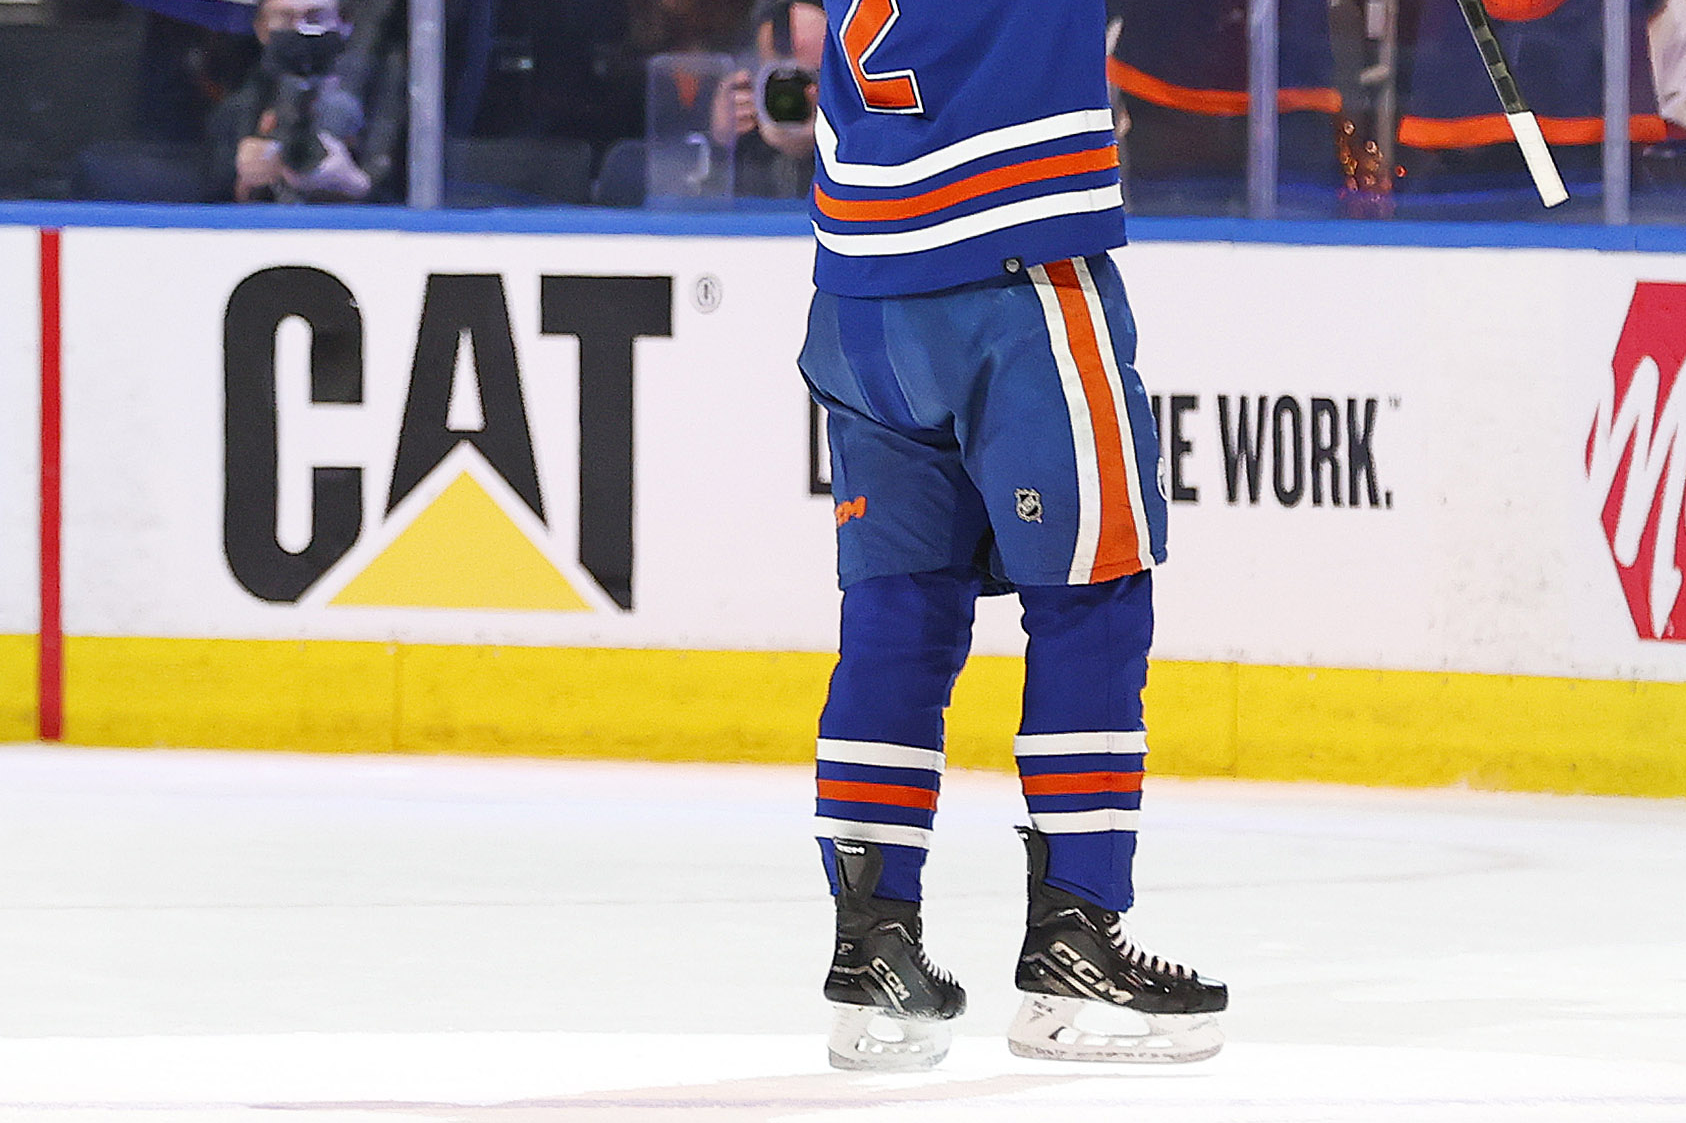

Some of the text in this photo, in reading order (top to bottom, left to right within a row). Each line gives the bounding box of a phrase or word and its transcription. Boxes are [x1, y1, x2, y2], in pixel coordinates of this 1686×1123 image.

[224, 265, 674, 611] CAT
[1216, 395, 1395, 509] WORK.
[871, 957, 911, 1001] CCM
[1050, 940, 1135, 1005] CCM
